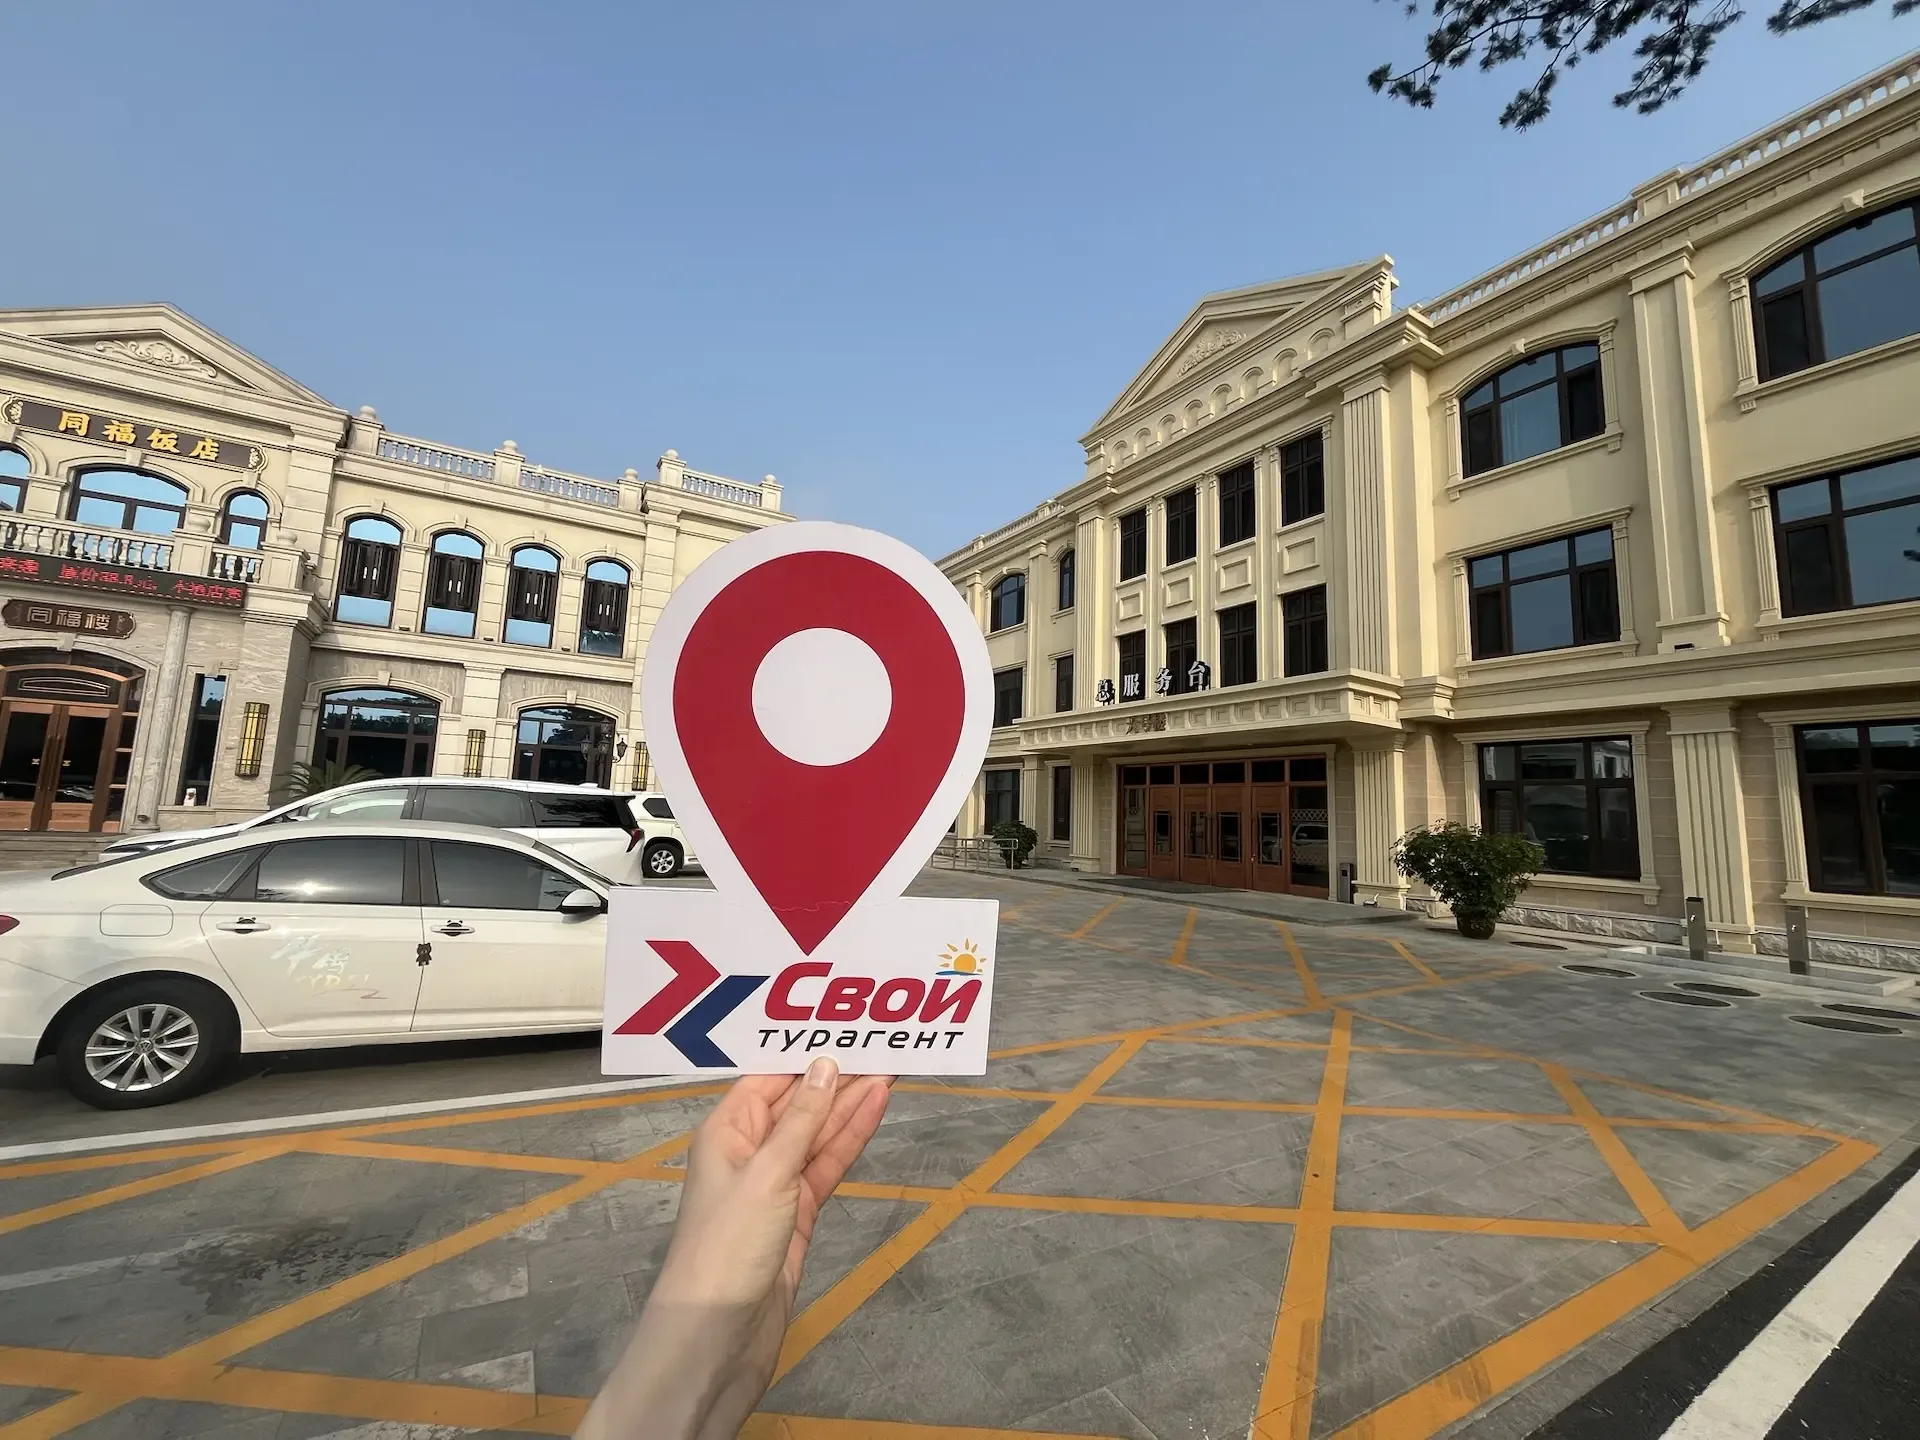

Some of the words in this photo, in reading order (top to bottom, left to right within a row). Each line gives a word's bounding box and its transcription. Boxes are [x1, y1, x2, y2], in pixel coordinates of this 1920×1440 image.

[58, 410, 220, 462] 同福饭店
[26, 606, 111, 632] 同福楼
[1096, 660, 1211, 702] 总服务台
[764, 961, 983, 1024] Свой
[757, 1028, 964, 1052] турагент
